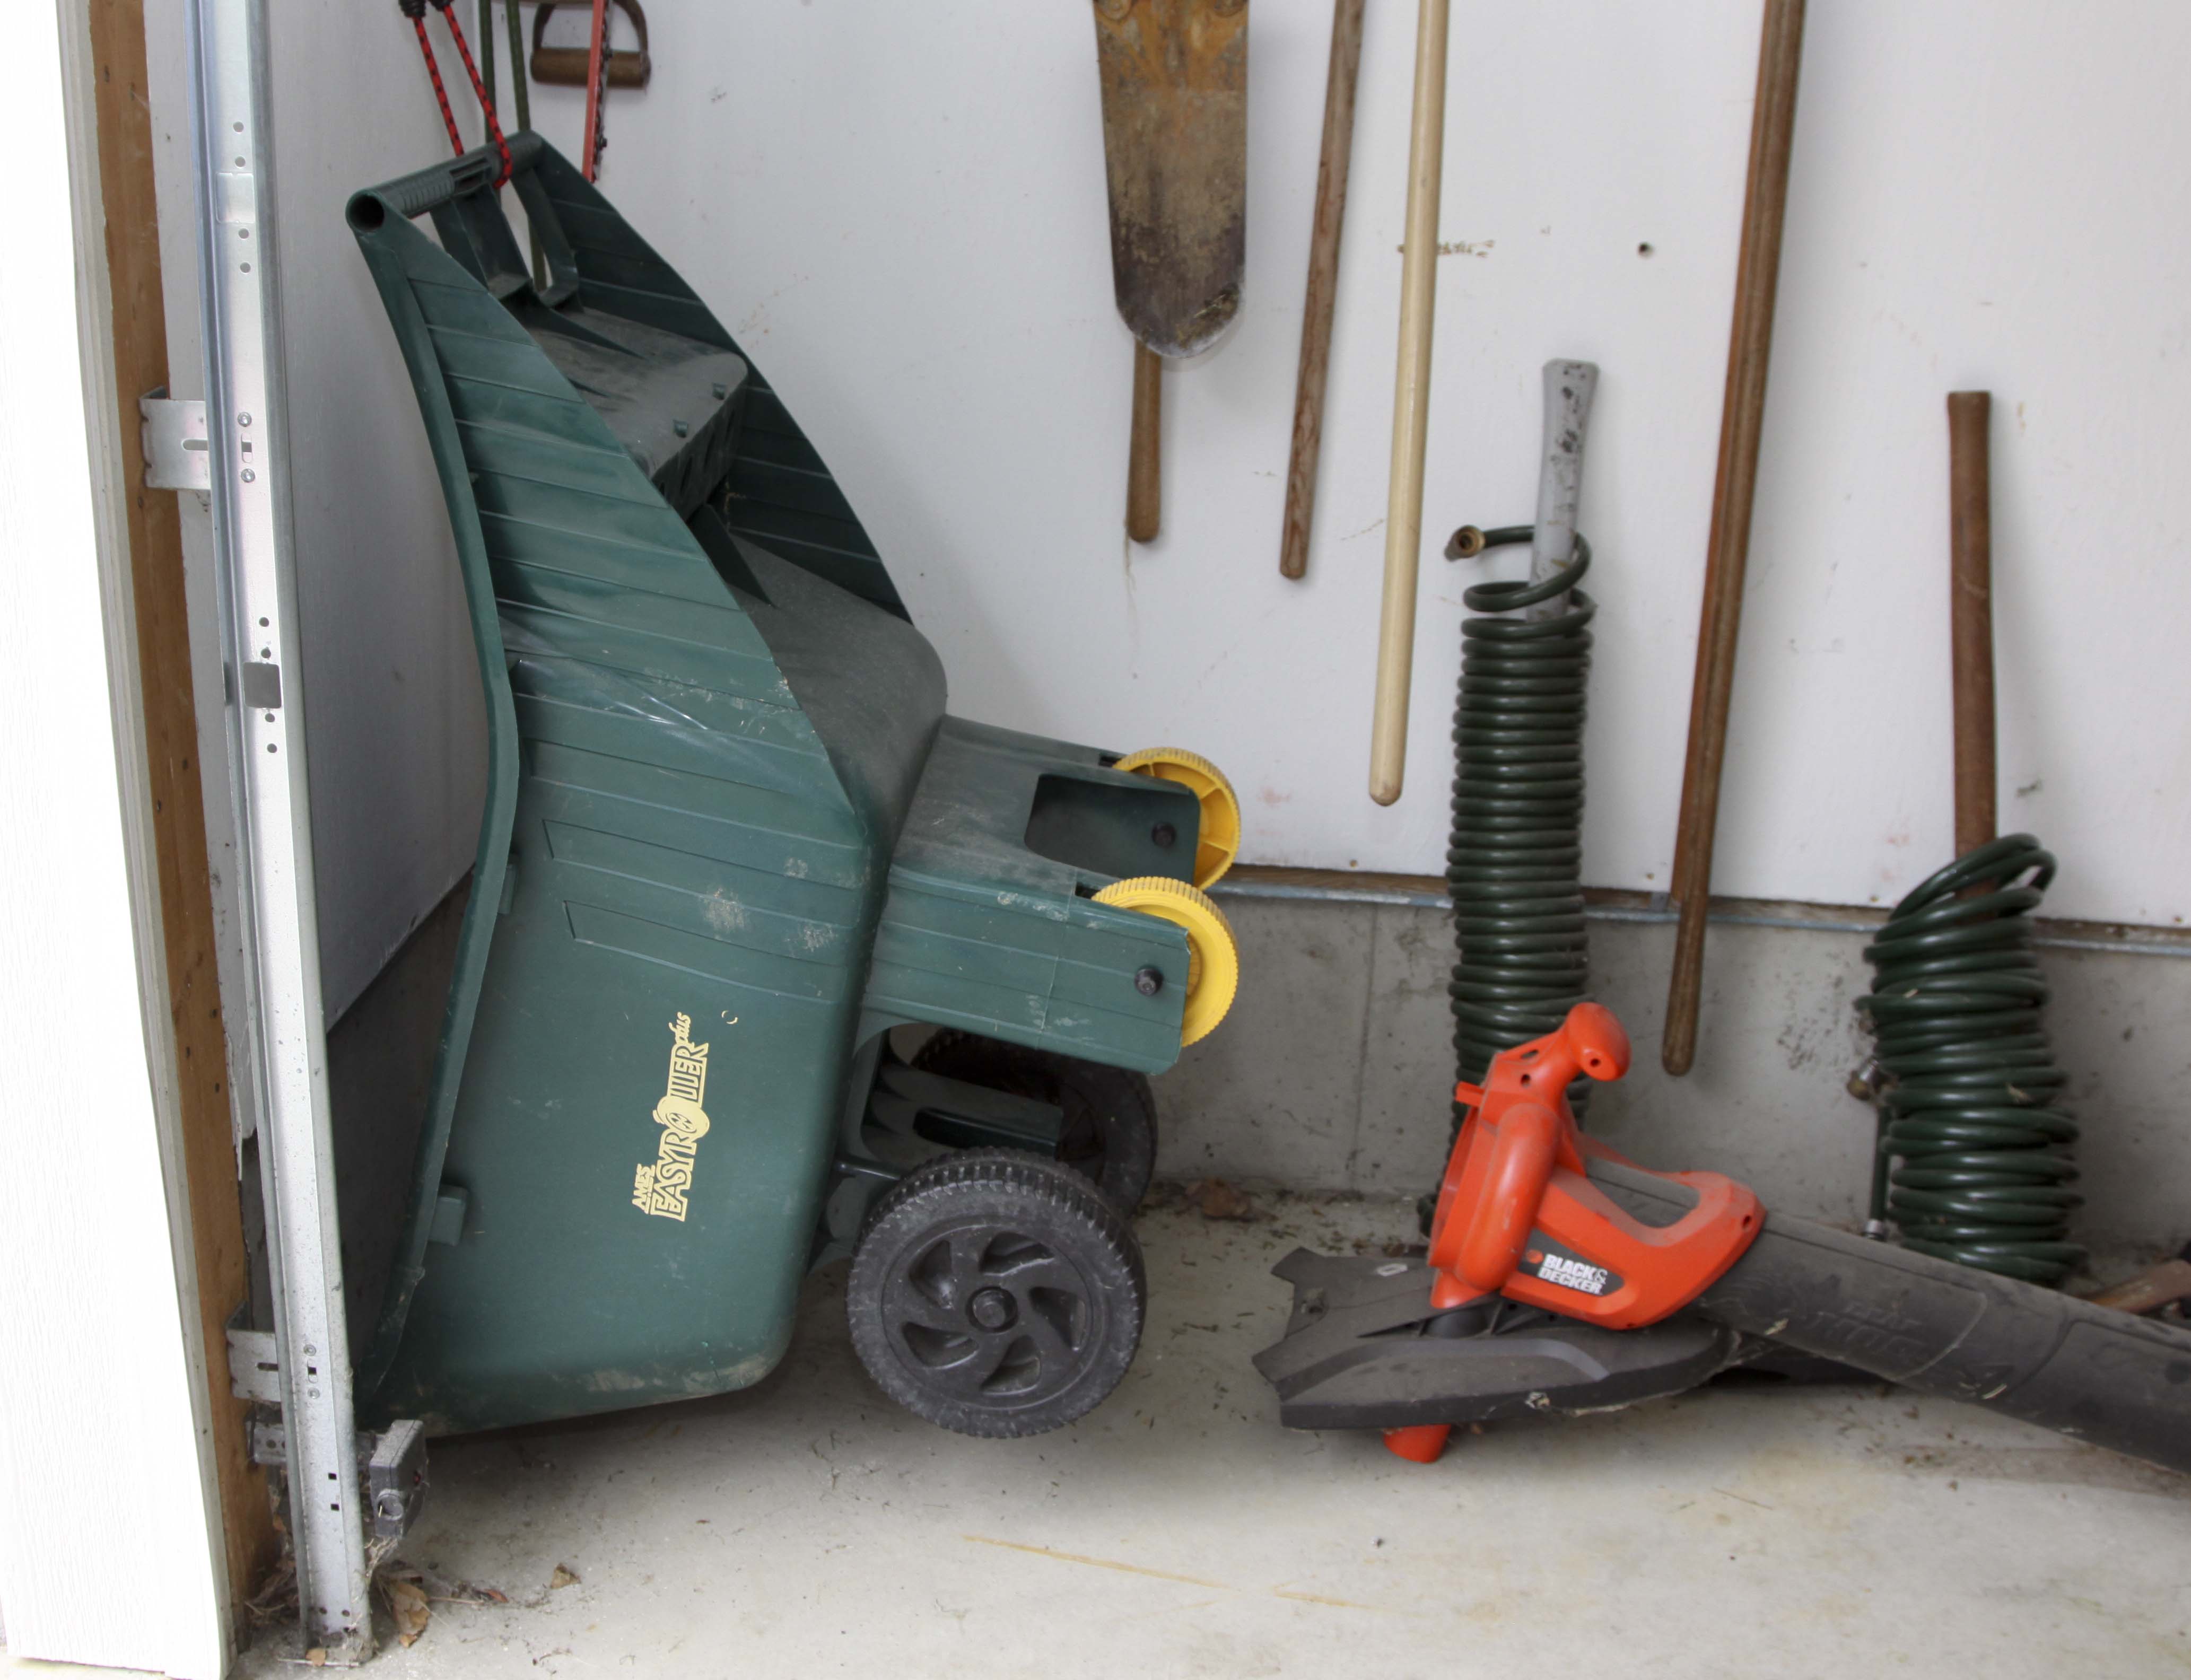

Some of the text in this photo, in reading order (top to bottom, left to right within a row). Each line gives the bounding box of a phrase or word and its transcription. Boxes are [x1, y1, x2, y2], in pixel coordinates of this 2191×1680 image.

[669, 1012, 691, 1045] plus
[632, 1163, 654, 1214] AMES
[1539, 1267, 1603, 1295] DECKER
